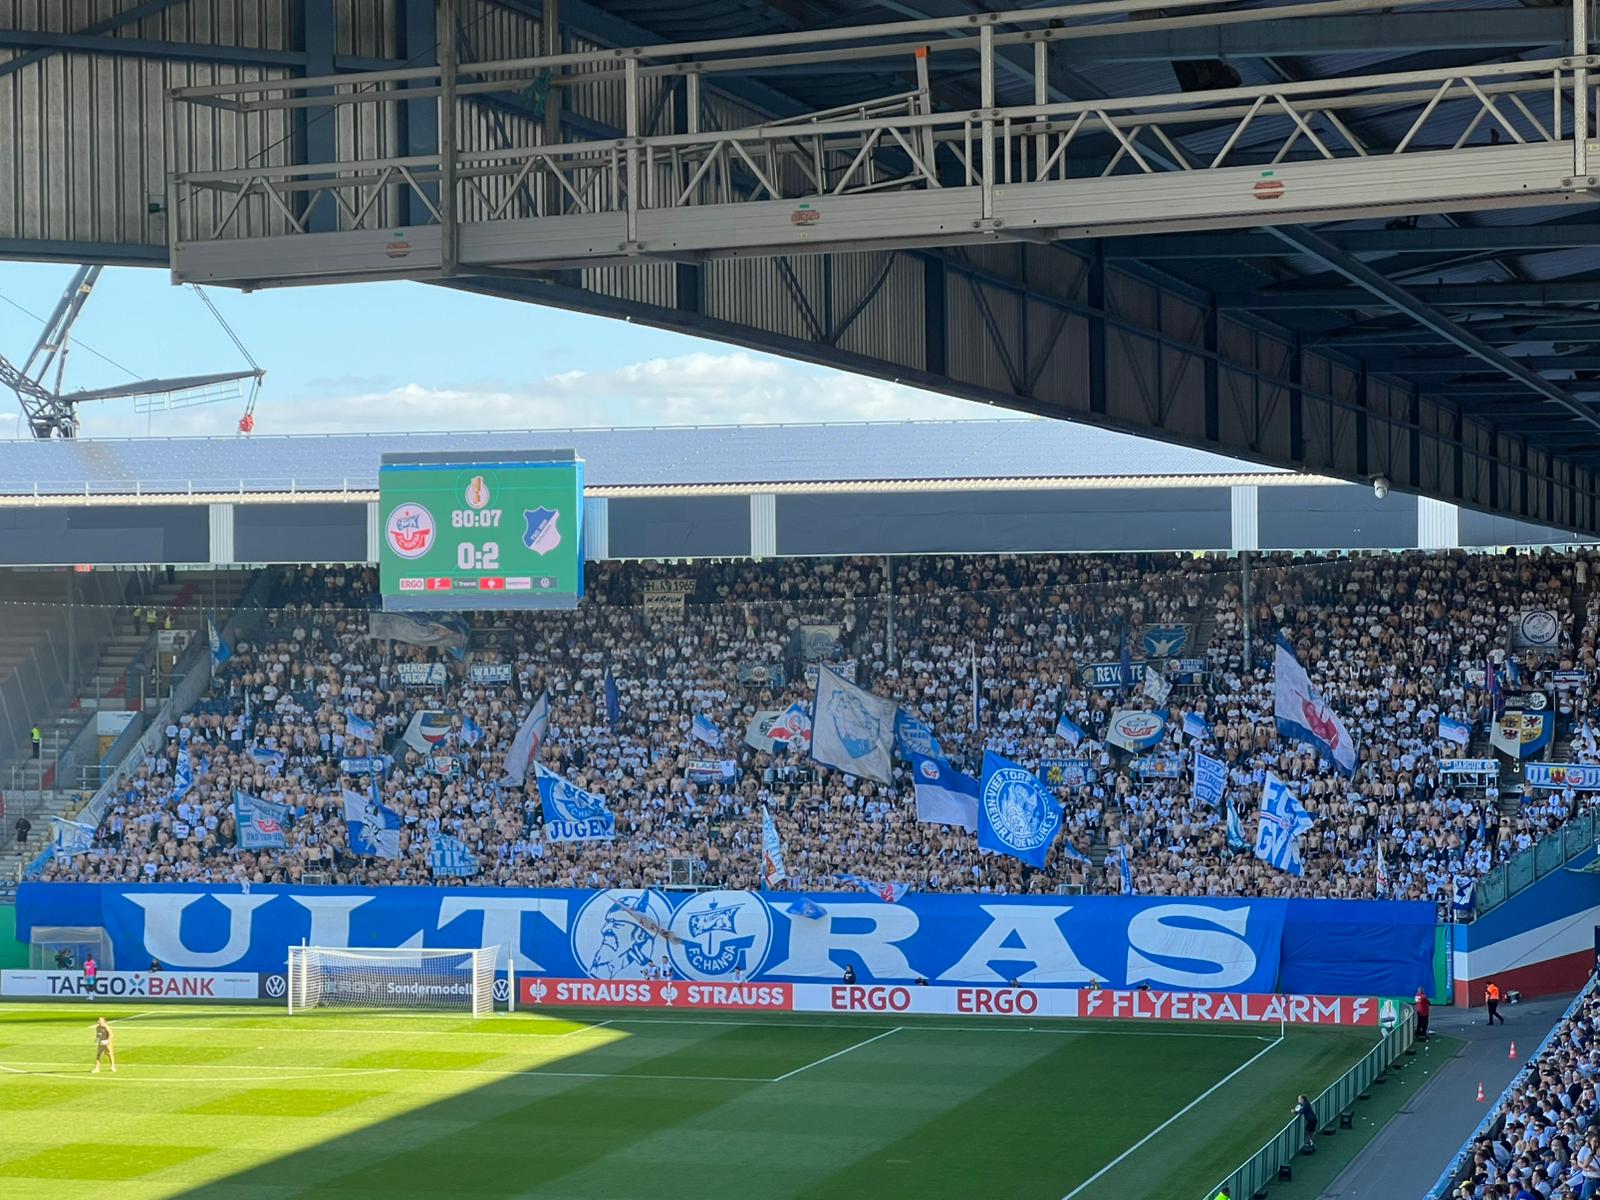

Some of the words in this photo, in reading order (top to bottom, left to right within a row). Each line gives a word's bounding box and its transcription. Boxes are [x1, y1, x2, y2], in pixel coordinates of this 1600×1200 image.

[452, 510, 501, 527] 80:07
[457, 542, 499, 569] 0:2
[401, 580, 423, 589] ERGO
[398, 663, 430, 673] CHAOS
[473, 664, 510, 677] WAREN
[400, 673, 428, 683] CREW
[556, 983, 651, 1002] STRAUSS
[687, 986, 784, 1006] STRAUSS
[831, 986, 911, 1011] ERGO
[957, 989, 1038, 1014] ERGO
[1113, 991, 1341, 1024] FLYERALARM
